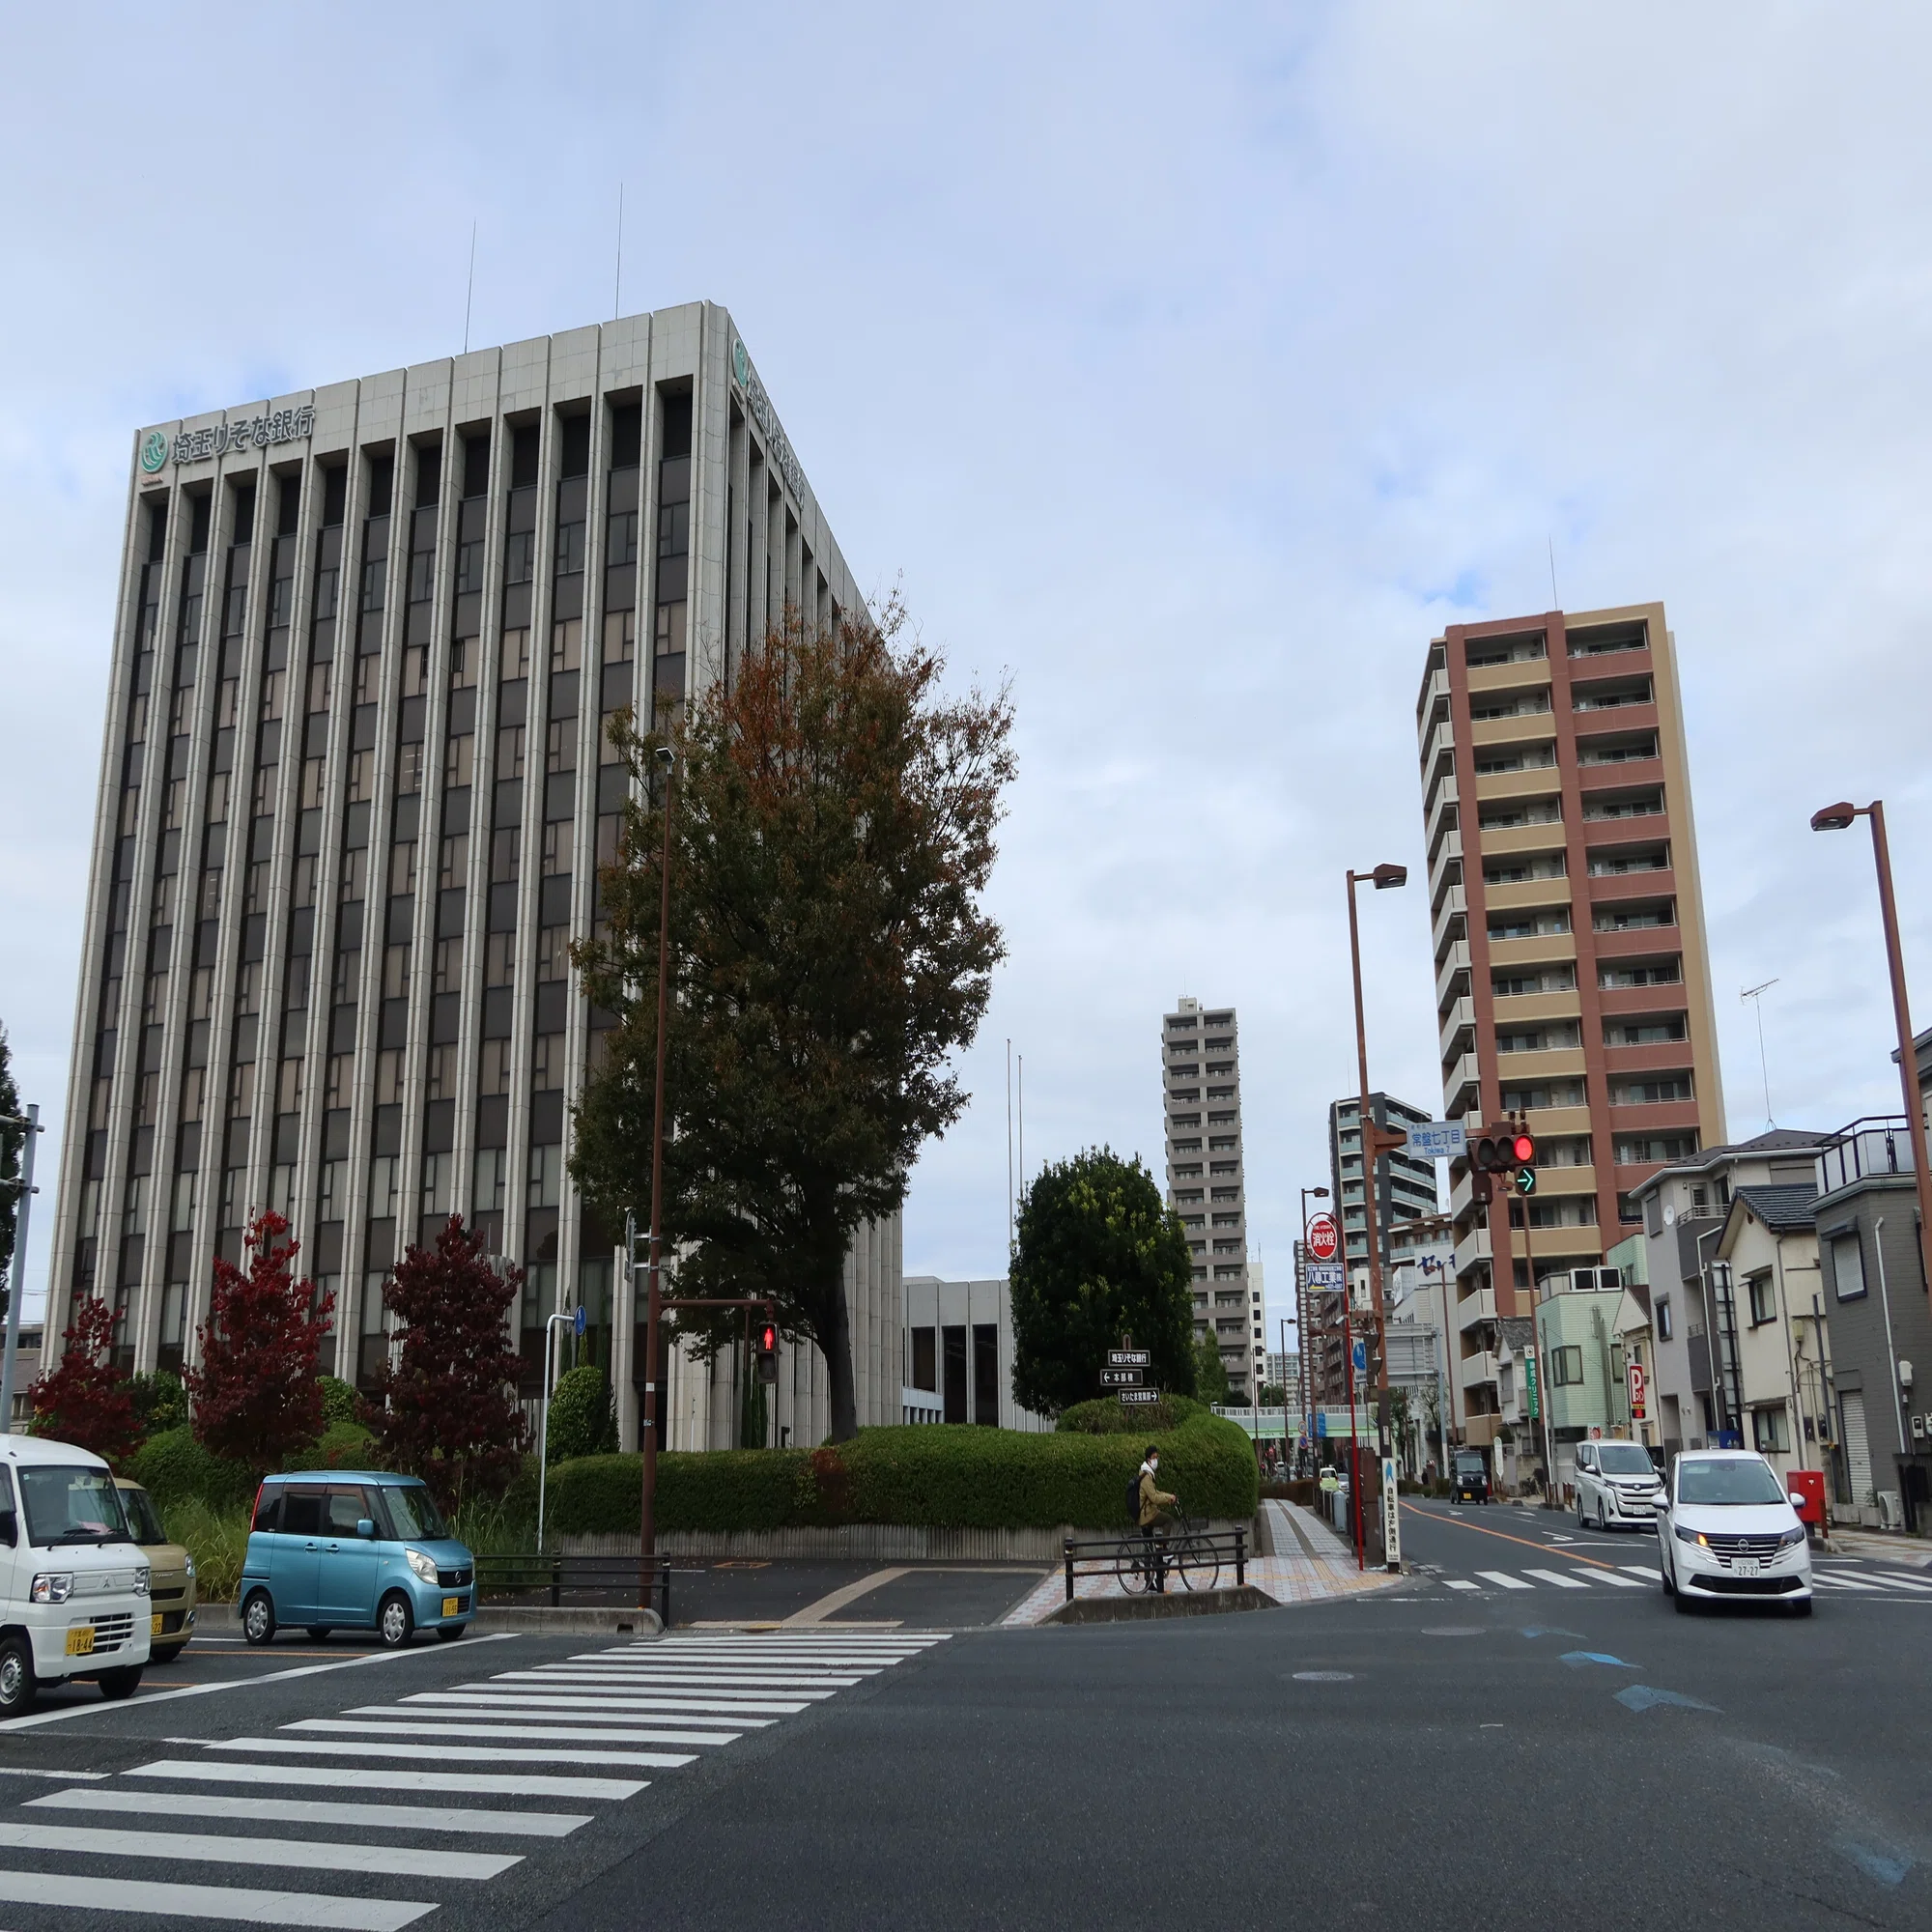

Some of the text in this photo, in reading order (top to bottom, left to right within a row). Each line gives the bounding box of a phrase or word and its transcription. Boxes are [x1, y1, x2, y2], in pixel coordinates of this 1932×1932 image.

[171, 405, 315, 465] 埼玉りそな銀行
[1412, 1129, 1460, 1147] 常盤七丁目
[1312, 1231, 1335, 1247] 消火栓
[1112, 1353, 1147, 1363] 埼玉りそな銀行
[1387, 1487, 1396, 1552] 自転車は左側通行
[1738, 1566, 1758, 1576] 27-27
[71, 1637, 93, 1653] 18-44
